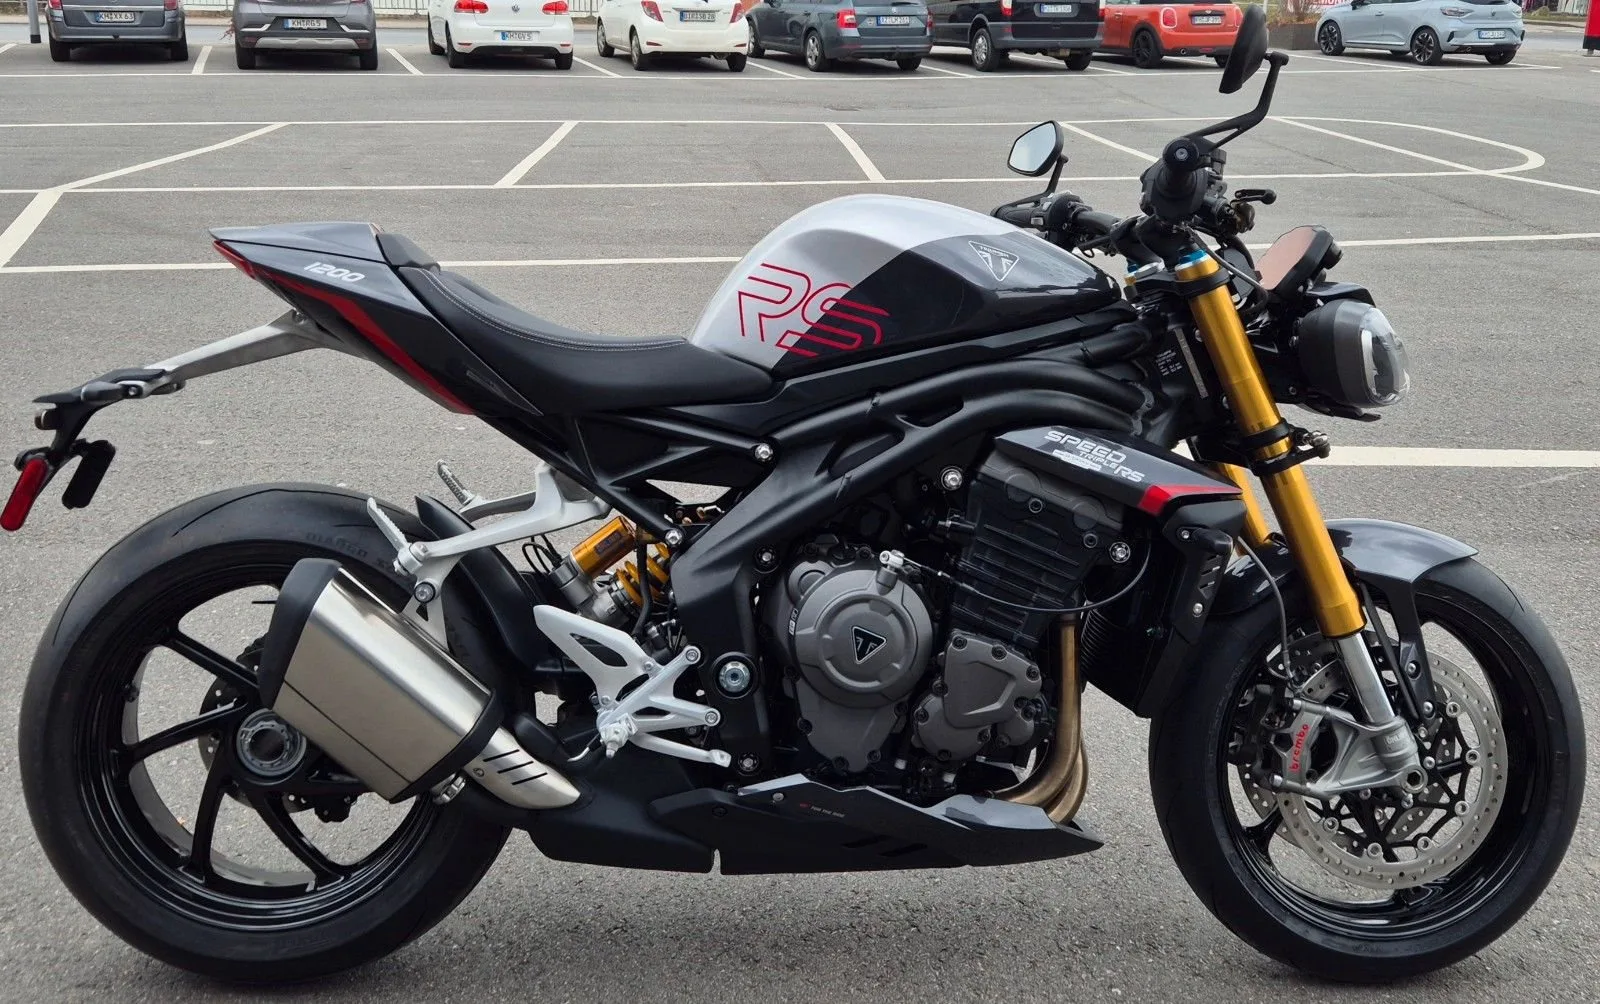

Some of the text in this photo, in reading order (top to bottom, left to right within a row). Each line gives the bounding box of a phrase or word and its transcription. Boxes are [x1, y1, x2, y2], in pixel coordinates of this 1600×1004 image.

[303, 261, 366, 282] 1200
[737, 262, 891, 358] RS
[1044, 430, 1127, 464] SPEED
[1113, 465, 1145, 483] RS
[1289, 724, 1309, 771] brembo
